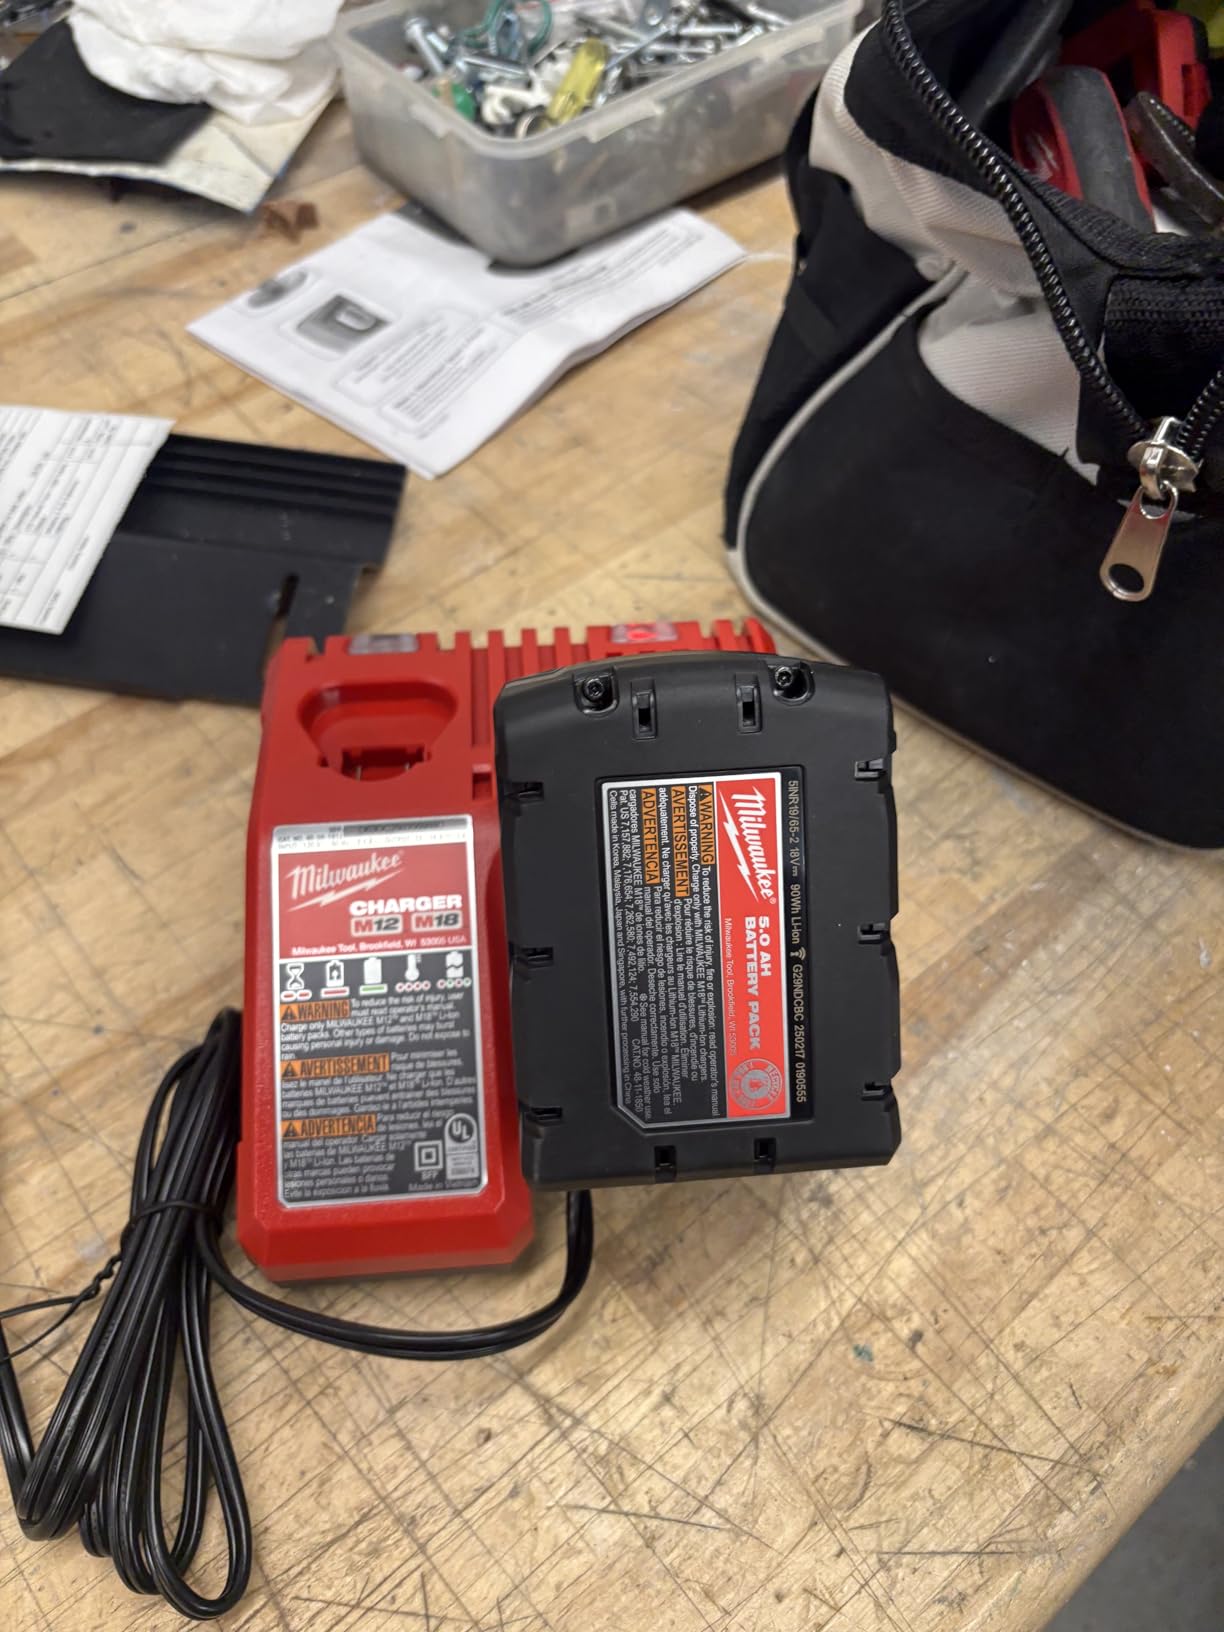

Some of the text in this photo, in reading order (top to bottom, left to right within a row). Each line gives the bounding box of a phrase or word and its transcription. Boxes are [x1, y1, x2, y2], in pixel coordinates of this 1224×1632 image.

[608, 790, 618, 809] Cells
[686, 785, 697, 817] Dispose
[610, 811, 619, 831] made
[619, 807, 628, 819] US
[627, 789, 639, 833] cargadores
[787, 780, 799, 843] 5INR19/65-2
[689, 819, 698, 827] of
[699, 800, 714, 863] WARNING
[642, 790, 659, 881] ADVERTENCIA
[671, 788, 689, 895] AVERTISSEMENT
[688, 828, 699, 861] properly.
[611, 843, 621, 867] Korea,
[631, 834, 642, 885] MILWAUKEE
[661, 847, 670, 858] Ne
[660, 860, 671, 890] charger
[690, 863, 701, 892] Charge
[701, 866, 710, 876] To
[643, 886, 652, 914] manual
[653, 886, 662, 904] Para
[691, 893, 701, 909] only
[702, 877, 711, 903] reduce
[789, 883, 801, 913] 90Wh
[349, 893, 462, 916] CHARGER
[661, 891, 672, 921] qu'avec
[683, 898, 692, 916] Pour
[703, 905, 712, 918] the
[354, 913, 458, 933] M12 M18
[613, 906, 624, 930] Japan
[635, 911, 643, 922] de
[644, 916, 653, 928] del
[654, 906, 663, 932] reducir
[672, 898, 684, 941] d'explosion
[693, 911, 702, 927] with
[703, 919, 712, 933] risk
[616, 931, 624, 946] and
[635, 923, 645, 944] iones
[655, 934, 664, 942] el
[665, 922, 673, 934] les
[684, 918, 693, 944] réduire
[704, 934, 713, 942] of
[723, 917, 733, 957] Milwaukee
[790, 916, 802, 943] Li-ion
[636, 946, 645, 956] de
[643, 930, 655, 966] operador.
[654, 943, 665, 966] riesgo
[663, 935, 675, 974] chargeurs
[675, 947, 685, 962] Lire
[685, 946, 693, 954] le
[694, 929, 704, 978] MILWAUKEE
[703, 944, 714, 966] injury,
[758, 915, 770, 976] 5.0 AH
[657, 968, 665, 978] de
[676, 963, 685, 971] le
[684, 955, 694, 979] risque
[706, 968, 714, 980] fire
[724, 960, 734, 977] Tool,
[667, 975, 674, 985] au
[676, 972, 686, 1000] manuel
[686, 980, 695, 990] de
[706, 982, 713, 990] or
[745, 916, 760, 1050] BATTERY PACK
[657, 979, 667, 1013] lesiones,
[725, 979, 736, 1018] Brookfield,
[792, 963, 804, 1021] G29NDCBC
[298, 1000, 348, 1019] WARNING
[639, 1001, 648, 1016] See
[686, 992, 697, 1030] blessures,
[640, 1018, 649, 1045] manual
[728, 1020, 736, 1030] WI
[708, 1031, 717, 1048] read
[793, 1024, 805, 1058] 250217
[300, 1054, 387, 1076] AVERTISSEMENT
[690, 1071, 697, 1081] ou
[794, 1062, 806, 1102] 0190555
[301, 1114, 374, 1136] ADVERTENCIA
